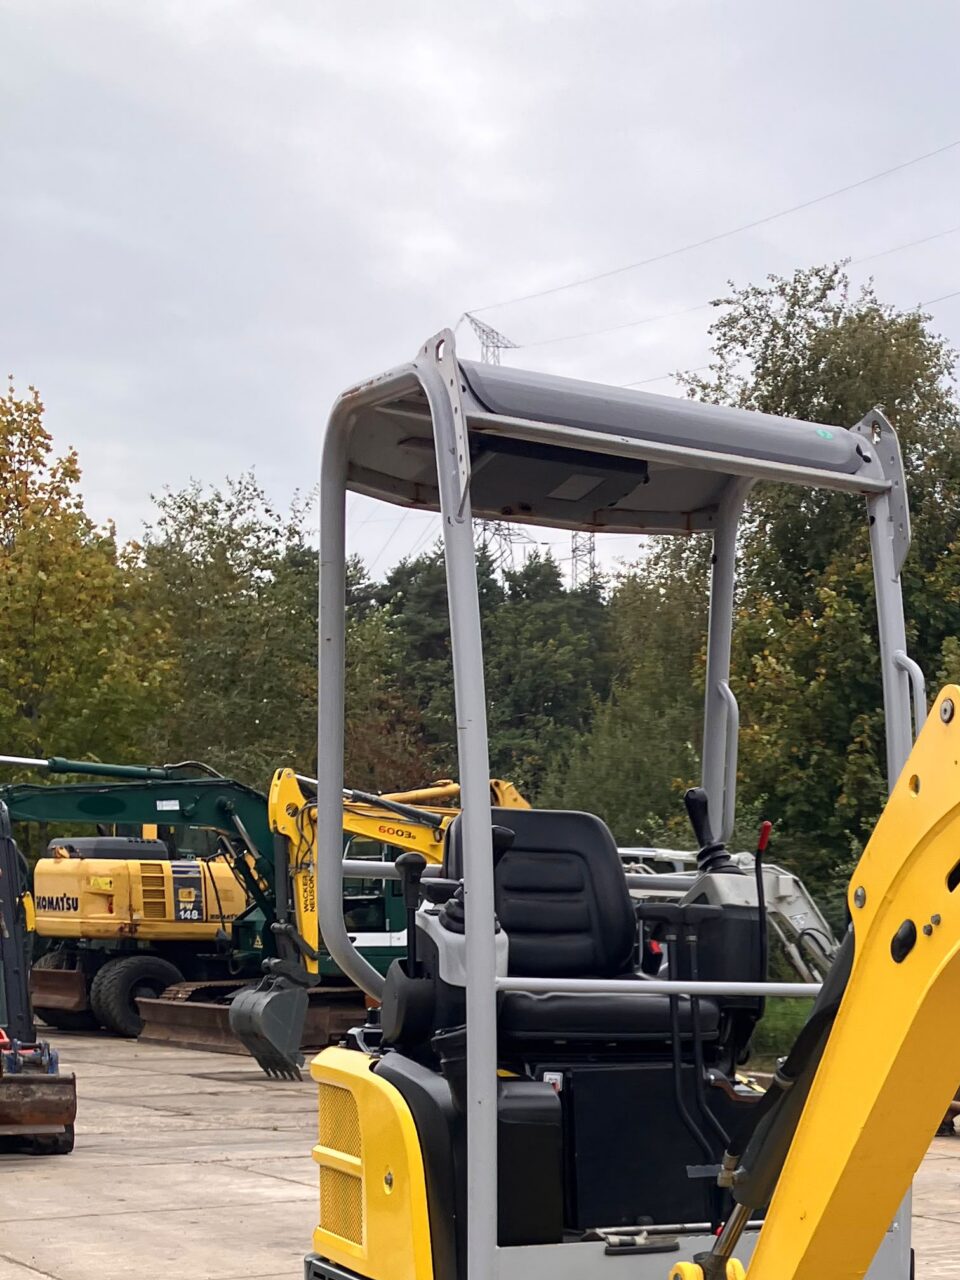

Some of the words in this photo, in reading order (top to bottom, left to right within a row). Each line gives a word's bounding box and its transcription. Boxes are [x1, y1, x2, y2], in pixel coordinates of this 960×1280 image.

[36, 893, 79, 911] KOMATSU
[180, 902, 193, 910] PW
[180, 910, 198, 920] 148
